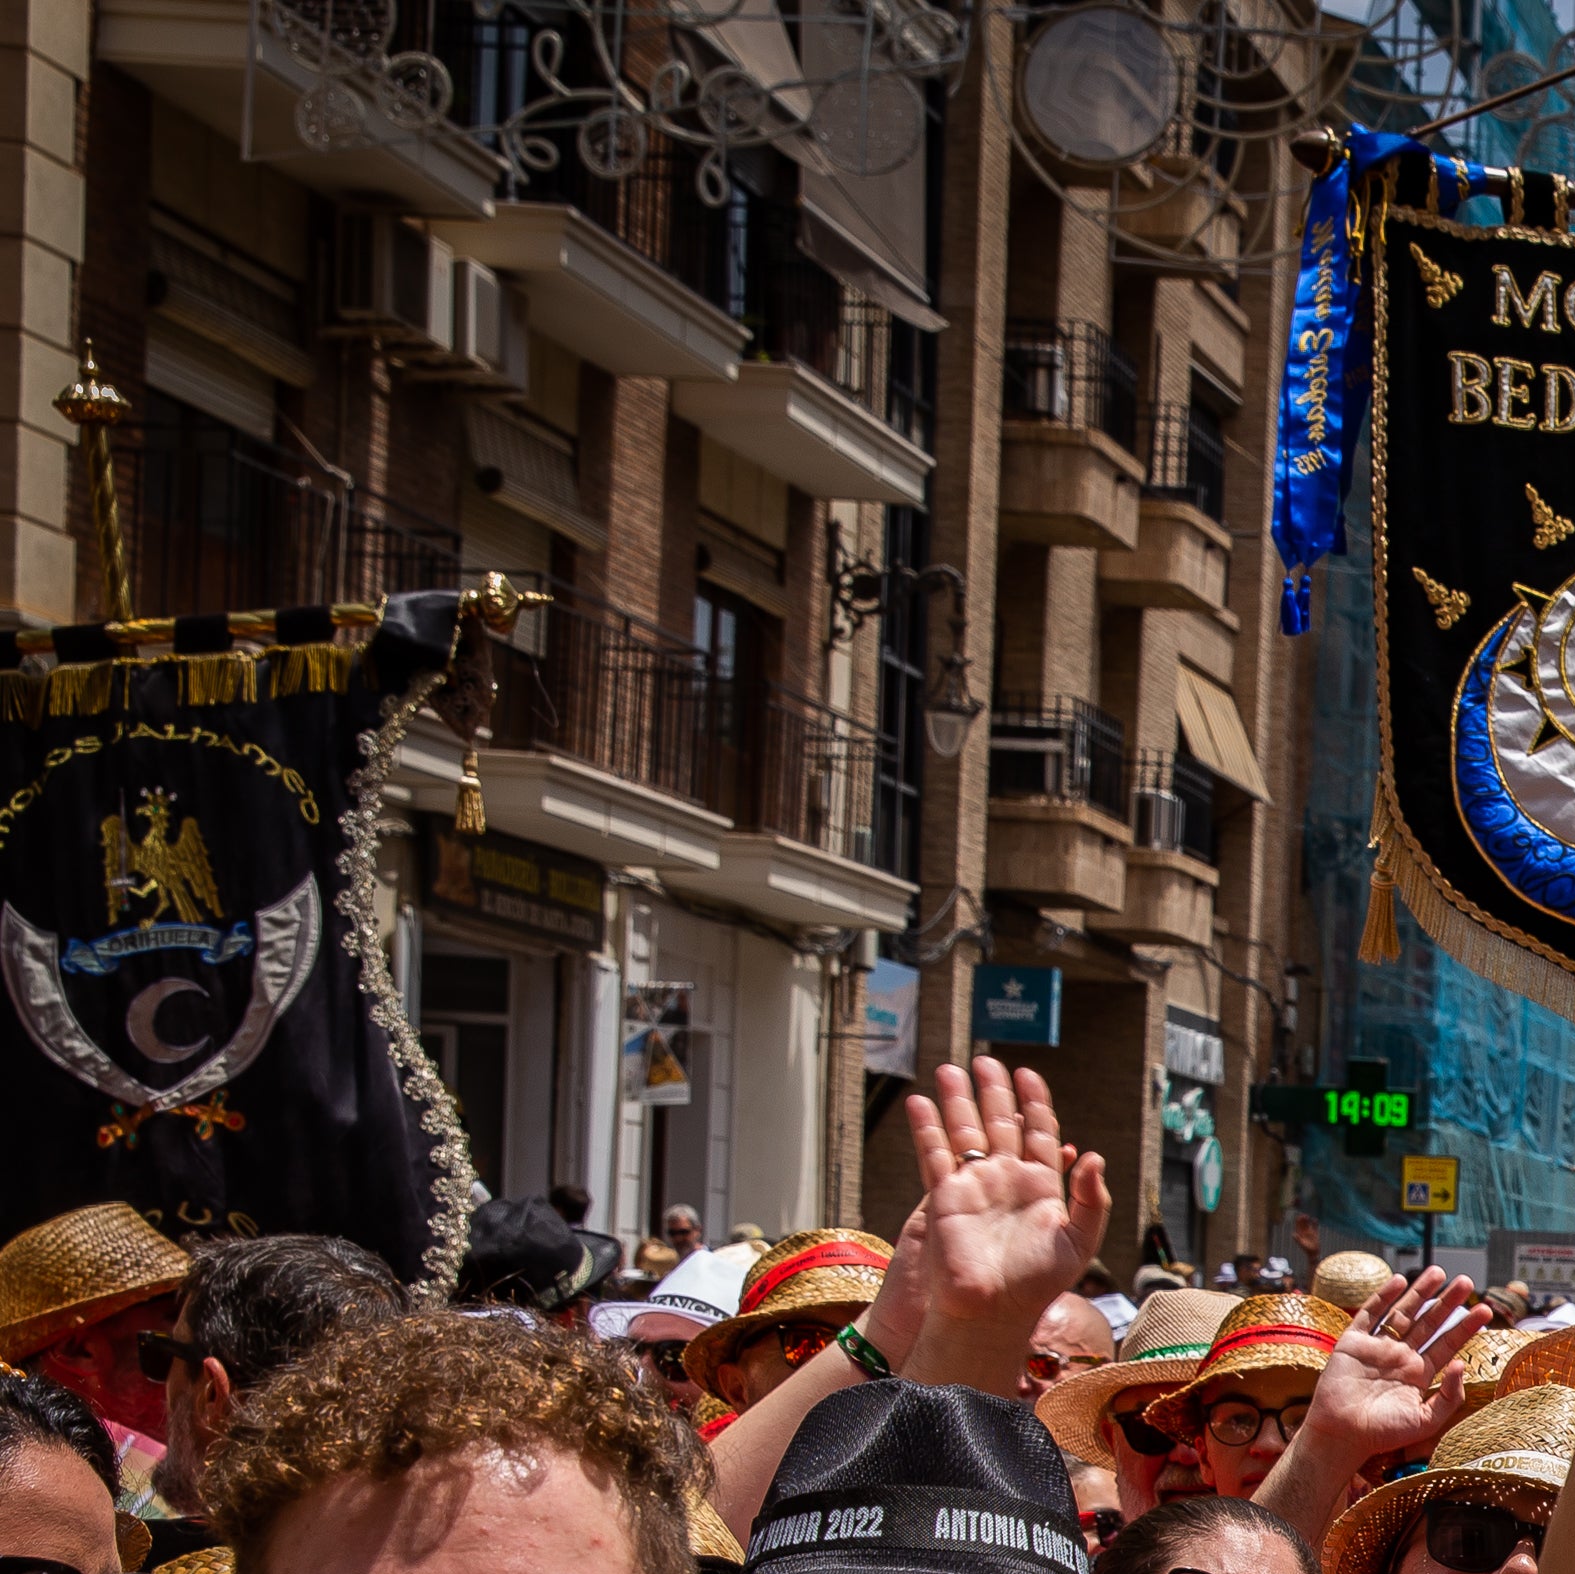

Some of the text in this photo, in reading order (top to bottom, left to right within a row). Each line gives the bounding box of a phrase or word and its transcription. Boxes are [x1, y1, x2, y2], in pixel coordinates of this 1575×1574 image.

[109, 929, 212, 953] ORIHUELA
[1324, 1090, 1409, 1128] 14:09
[824, 1505, 884, 1541] 2022
[934, 1507, 1030, 1551] ANTONIA
[1031, 1521, 1077, 1572] GÓMEZ
